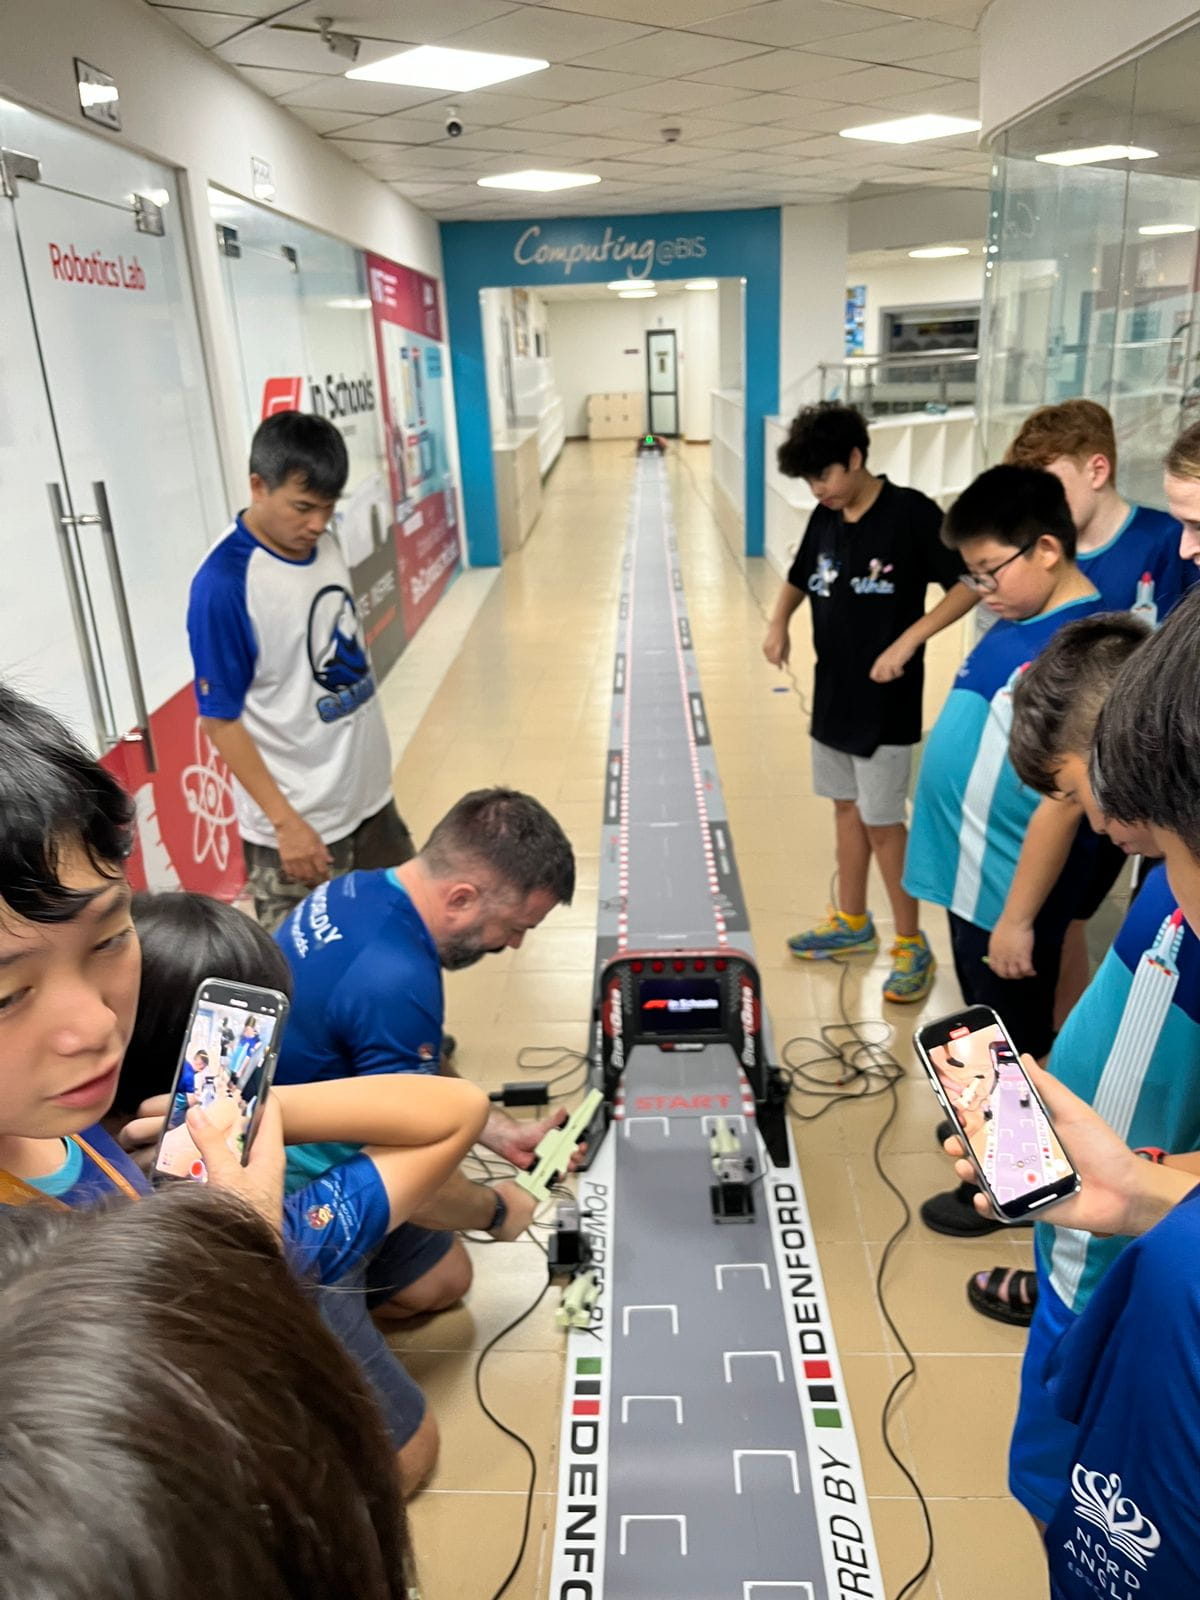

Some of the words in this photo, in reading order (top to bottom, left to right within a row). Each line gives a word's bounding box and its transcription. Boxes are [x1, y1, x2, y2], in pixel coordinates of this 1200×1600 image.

[49, 243, 120, 287] Robotics
[118, 255, 146, 290] Lab
[307, 374, 326, 415] in
[326, 372, 375, 418] Schools
[635, 1095, 732, 1110] START
[773, 1184, 827, 1354] DENFORD
[818, 1446, 857, 1504] BY
[829, 1514, 873, 1600] RED
[1076, 1526, 1140, 1589] NORD
